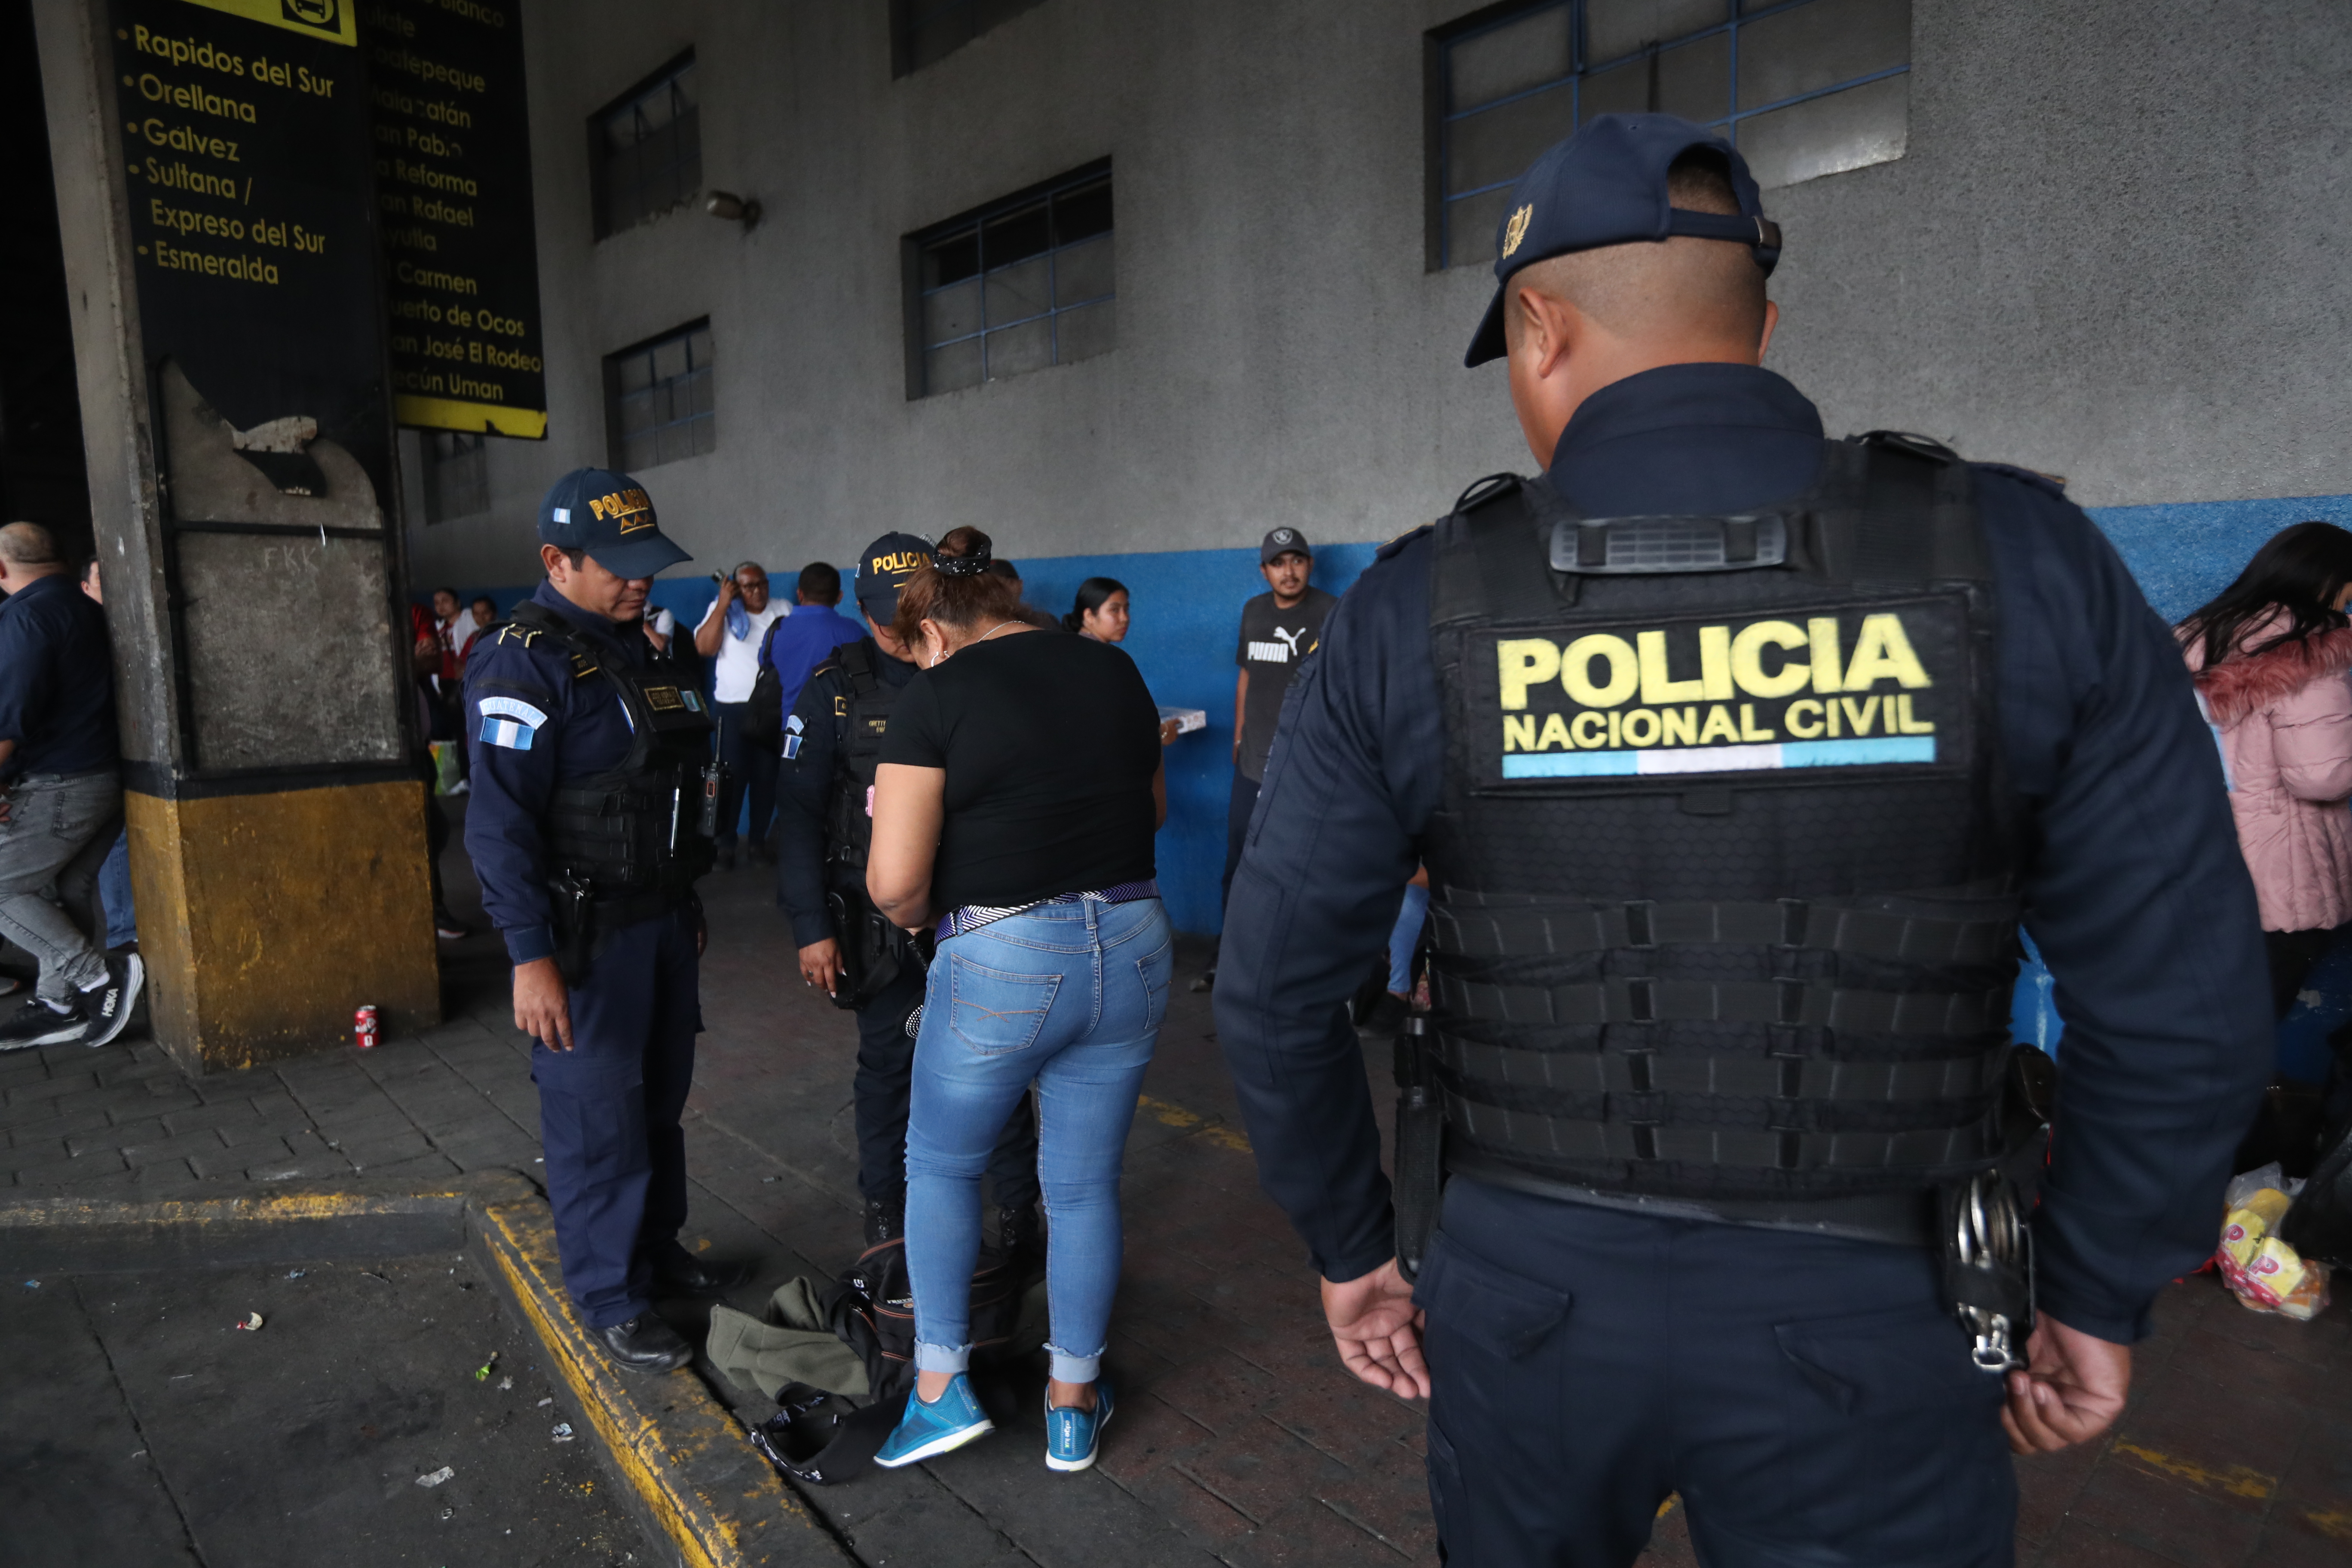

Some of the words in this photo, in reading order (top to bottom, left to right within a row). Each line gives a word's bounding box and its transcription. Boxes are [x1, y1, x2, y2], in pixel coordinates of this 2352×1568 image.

[135, 24, 244, 76] Rapidos
[252, 57, 292, 88] del
[298, 67, 334, 98] Sur
[139, 74, 256, 123] Orellana
[146, 157, 236, 199] Sultana
[245, 177, 252, 205] /
[395, 158, 478, 197] Reforma
[151, 199, 244, 239] Expreso
[252, 219, 287, 247] del
[294, 225, 325, 254] Sur
[413, 195, 475, 227] Rafael
[156, 240, 279, 285] Esmeralda
[397, 260, 478, 296] Carmen
[446, 304, 472, 328] de
[477, 309, 526, 337] Ocos
[423, 334, 465, 361] José
[469, 341, 483, 364] El
[486, 344, 542, 373] Rodeo
[448, 372, 504, 401] Uman
[872, 551, 931, 575] POLICIA
[1247, 641, 1288, 663] PUMA
[1497, 613, 1933, 710] POLICIA
[483, 700, 542, 725] GUATEMALA
[1503, 704, 1775, 752] NACIONAL
[1784, 694, 1936, 739] CIVIL
[102, 988, 119, 1017] HOKA
